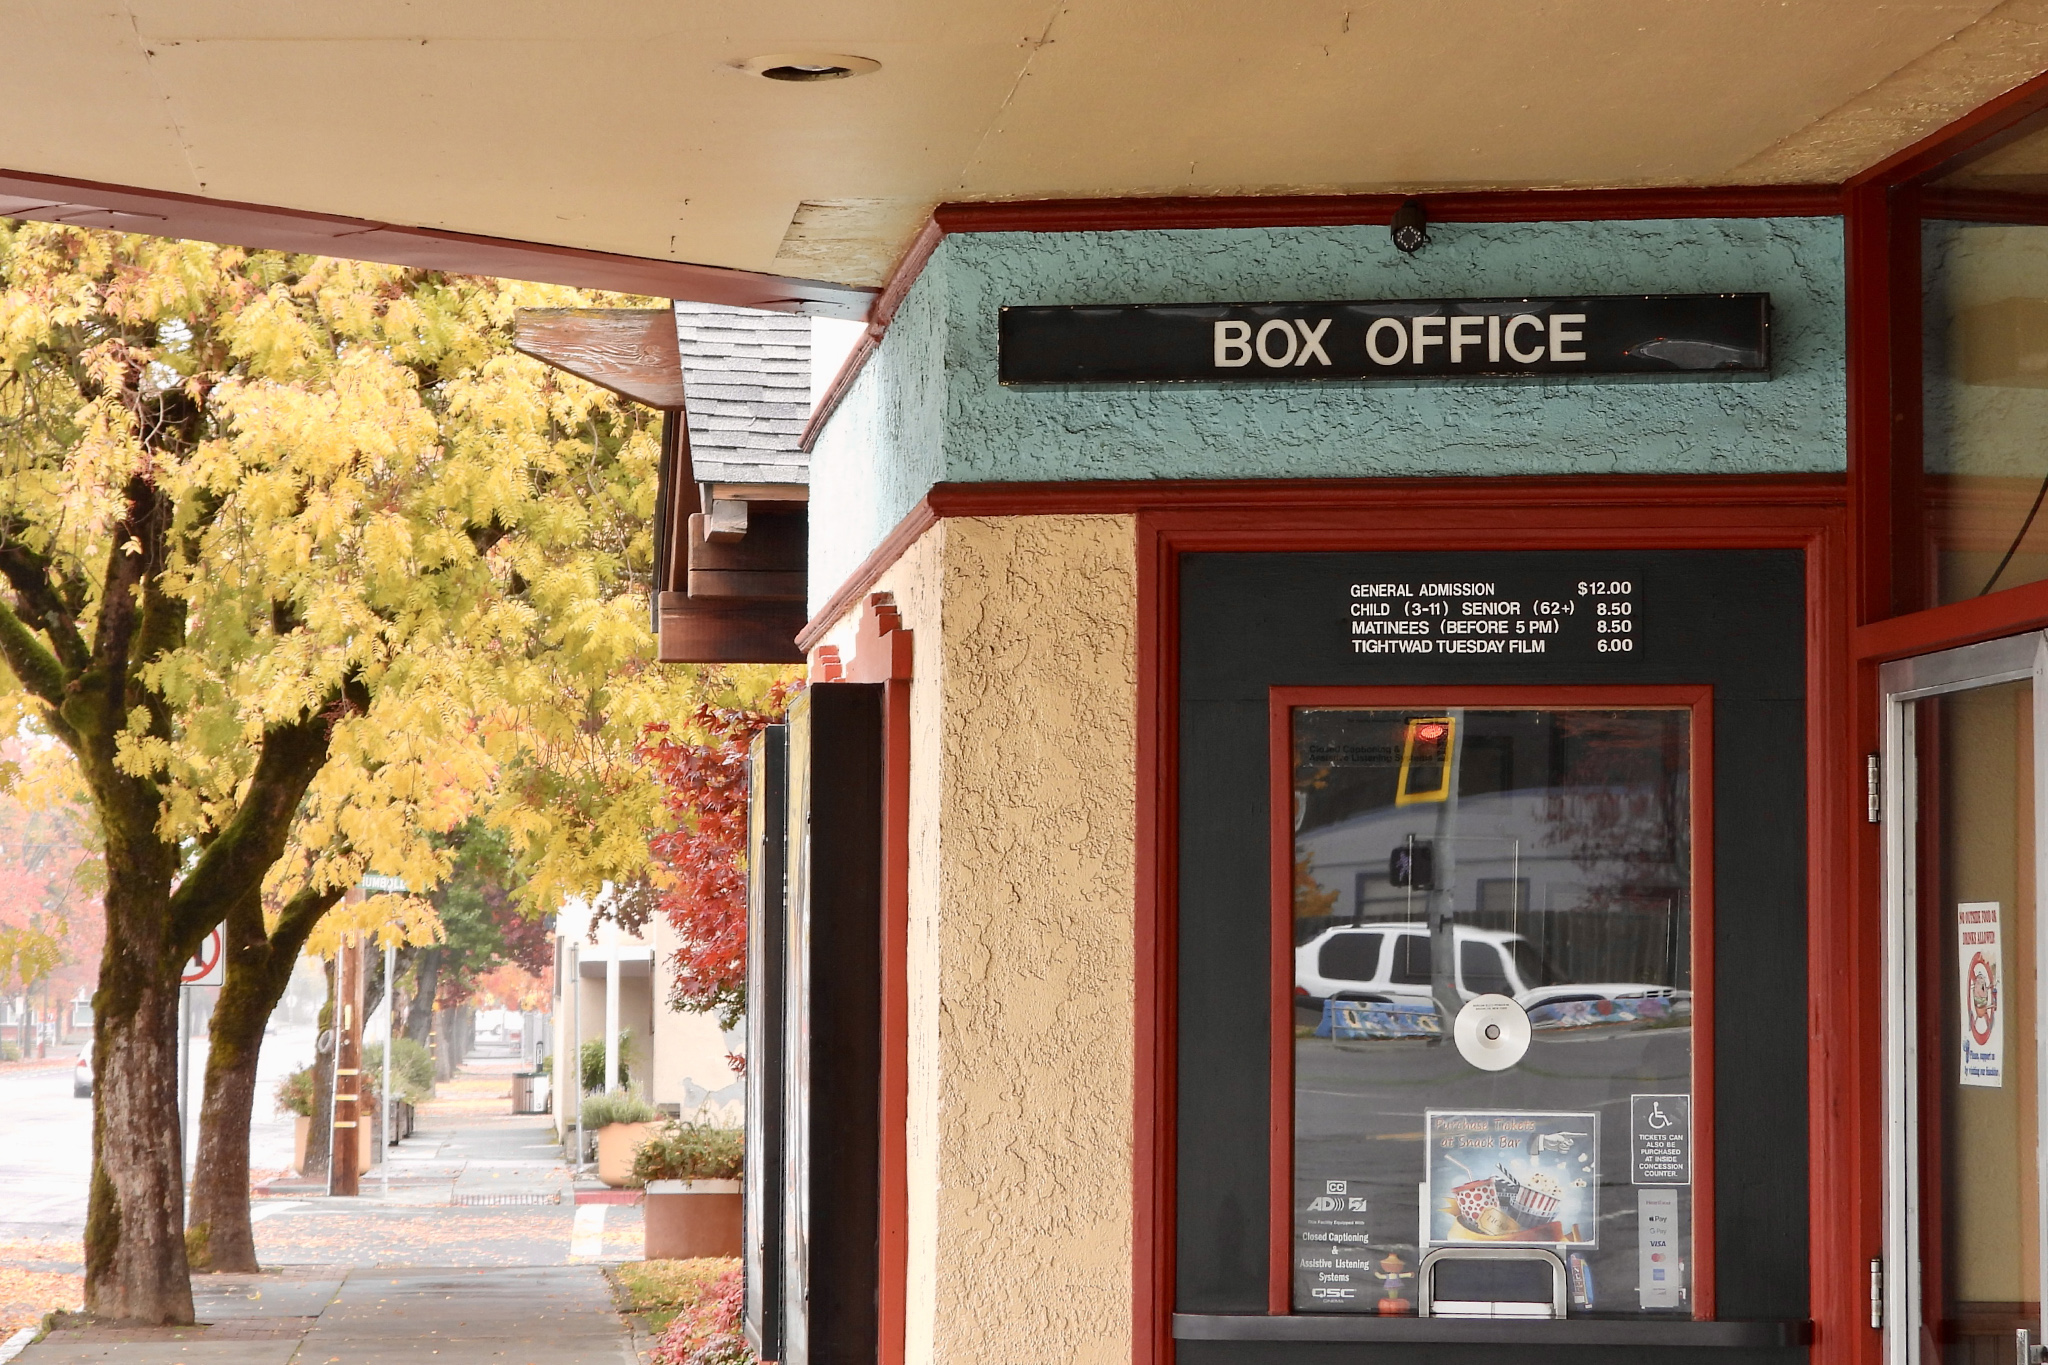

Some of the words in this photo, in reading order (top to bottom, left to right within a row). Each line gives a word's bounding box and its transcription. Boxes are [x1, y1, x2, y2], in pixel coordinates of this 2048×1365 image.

[1214, 319, 1332, 367] BOX
[1365, 314, 1586, 366] OFFICE
[1350, 584, 1414, 597] GENERAL
[1419, 583, 1495, 596] ADMISSION
[1578, 581, 1632, 597] $12.00
[1350, 603, 1390, 616] CHILD
[1404, 601, 1449, 616] (3-11)
[1462, 602, 1521, 615] SENIOR
[1533, 600, 1575, 616] (62+)
[1596, 602, 1632, 615] 8.50
[1352, 621, 1430, 634] MATINEES
[1440, 618, 1509, 634] (BEFORE
[1515, 620, 1526, 634] 5
[1529, 618, 1560, 634] PM)
[1596, 620, 1632, 633] 8.50
[1352, 640, 1433, 653] TIGHTWAD
[1436, 640, 1506, 653] TUESDAY
[1509, 640, 1546, 653] FILM
[1597, 638, 1633, 652] 6.00
[1436, 1118, 1489, 1132] Purchase
[1494, 1118, 1537, 1132] Tickets
[1441, 1138, 1454, 1148] at
[1459, 1136, 1494, 1148] Snack
[1499, 1136, 1522, 1149] Bar
[1329, 1182, 1344, 1193] CC
[1654, 1215, 1668, 1223] Pay
[1302, 1232, 1328, 1241] Closed
[1328, 1232, 1369, 1244] Captioning
[1656, 1228, 1667, 1236] Pay
[1331, 1245, 1339, 1255] &
[1300, 1258, 1333, 1268] Assistive
[1335, 1259, 1370, 1271] Listening
[1318, 1272, 1350, 1283] Systems
[1311, 1288, 1355, 1298] QSC
